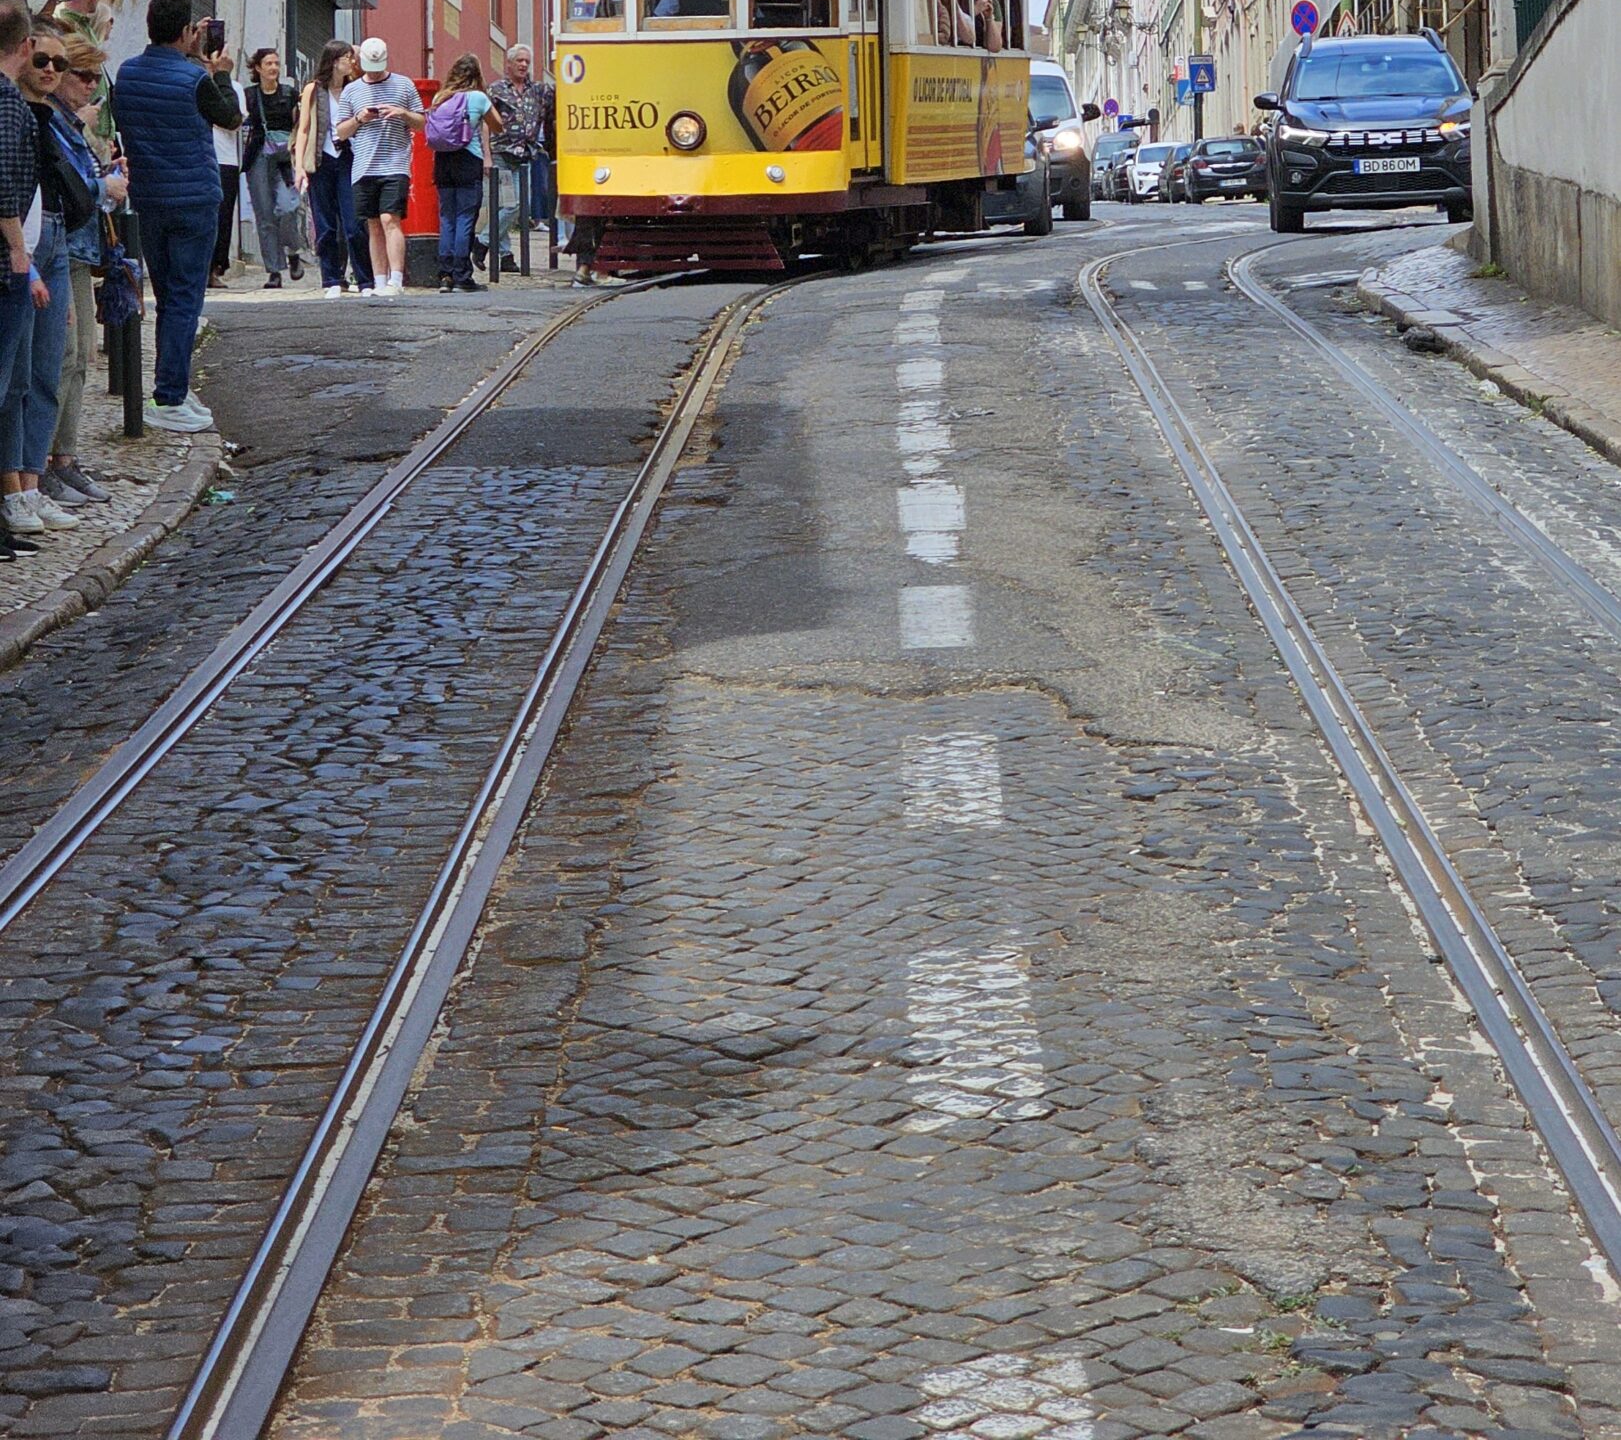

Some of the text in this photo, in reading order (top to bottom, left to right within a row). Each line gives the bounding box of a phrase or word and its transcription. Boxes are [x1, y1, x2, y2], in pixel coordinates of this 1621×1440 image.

[774, 64, 806, 86] LICOR
[754, 64, 840, 133] BEIRÃO
[567, 100, 659, 131] BEIRÃO
[778, 109, 800, 132] LICOR
[800, 101, 811, 112] DE
[1363, 159, 1416, 172] BD 86 OM
